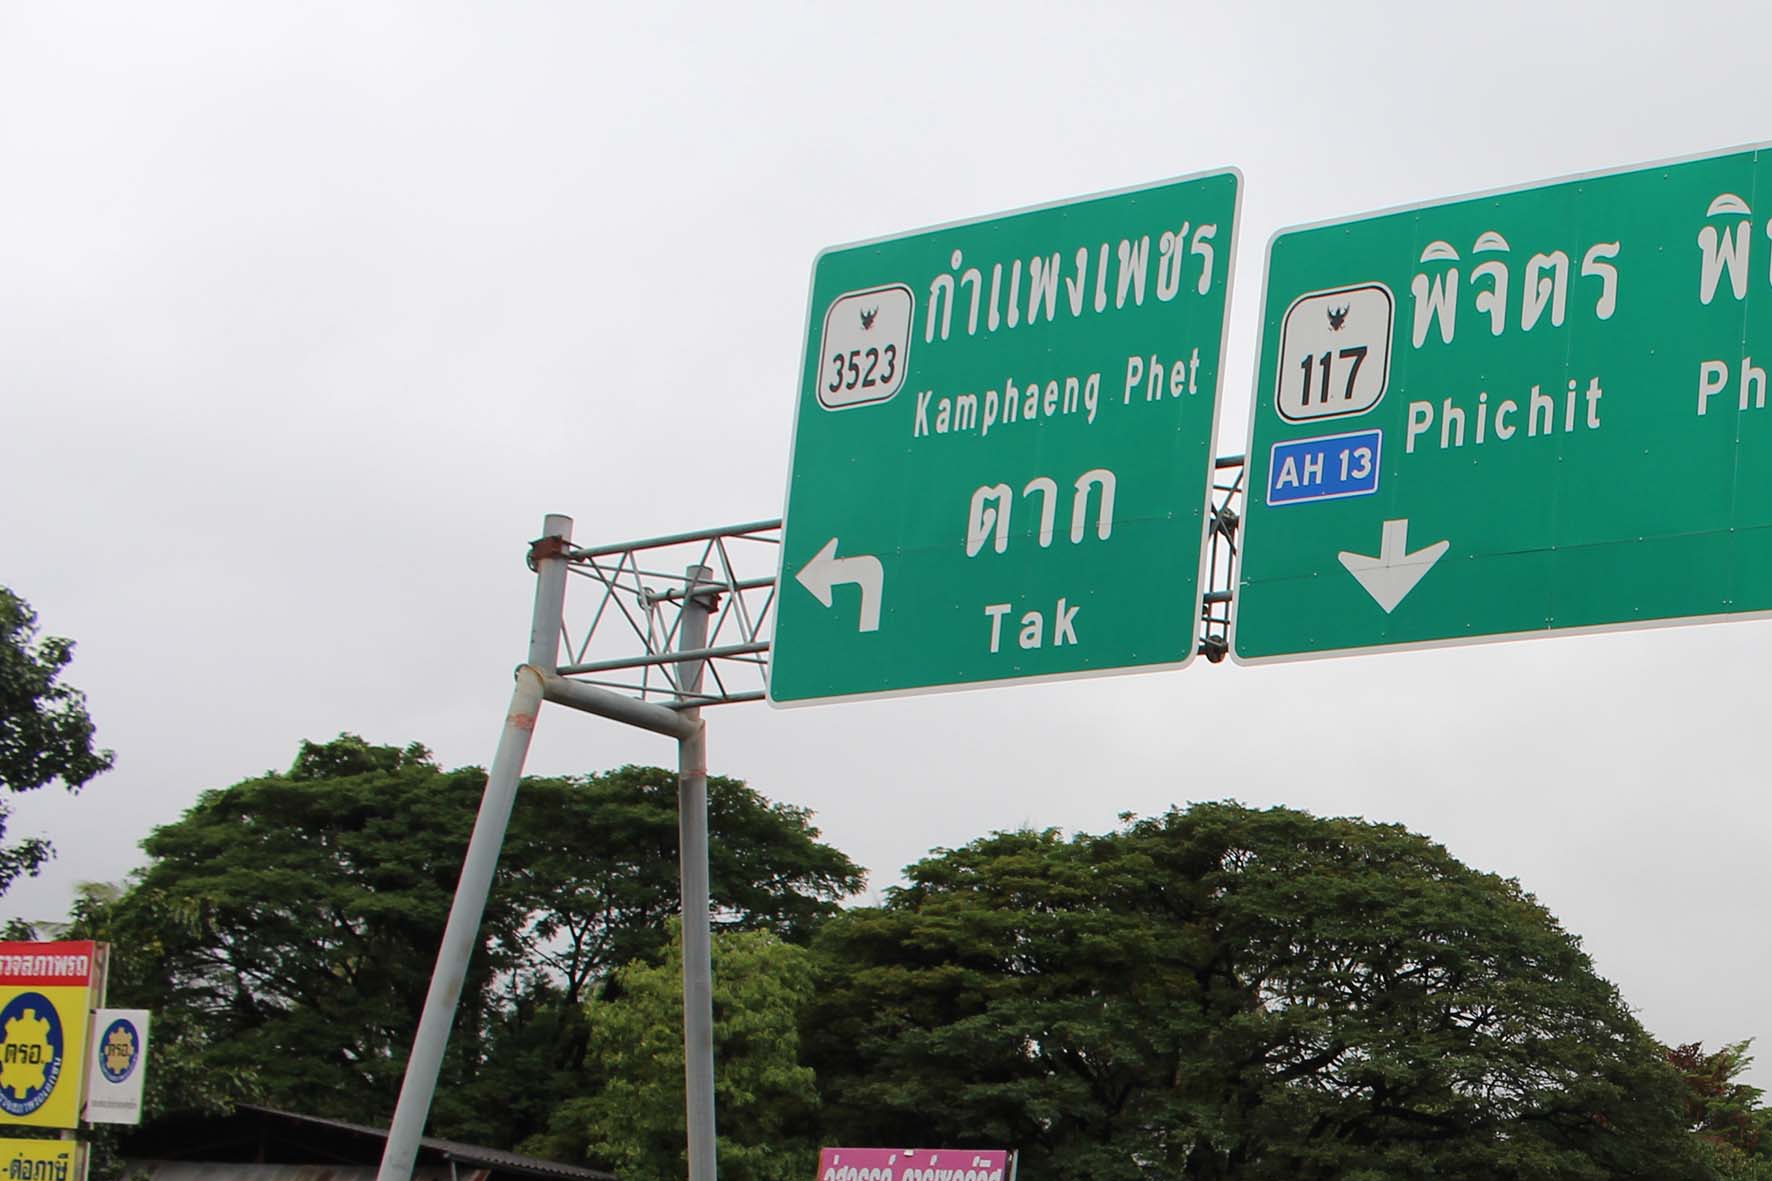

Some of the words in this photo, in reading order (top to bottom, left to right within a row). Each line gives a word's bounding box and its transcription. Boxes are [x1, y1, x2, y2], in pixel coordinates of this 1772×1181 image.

[925, 221, 1216, 343] กำแพงเพชร
[1411, 230, 1620, 349] พิจิตร
[829, 344, 896, 393] 3523
[914, 373, 1100, 437] Kamphaeng
[1124, 347, 1199, 404] Phet
[1301, 346, 1367, 406] 117
[1406, 375, 1602, 453] Phichit
[1276, 453, 1324, 489] AH
[1340, 447, 1372, 481] 13
[966, 469, 1116, 557] ตาก
[985, 597, 1080, 653] Tak
